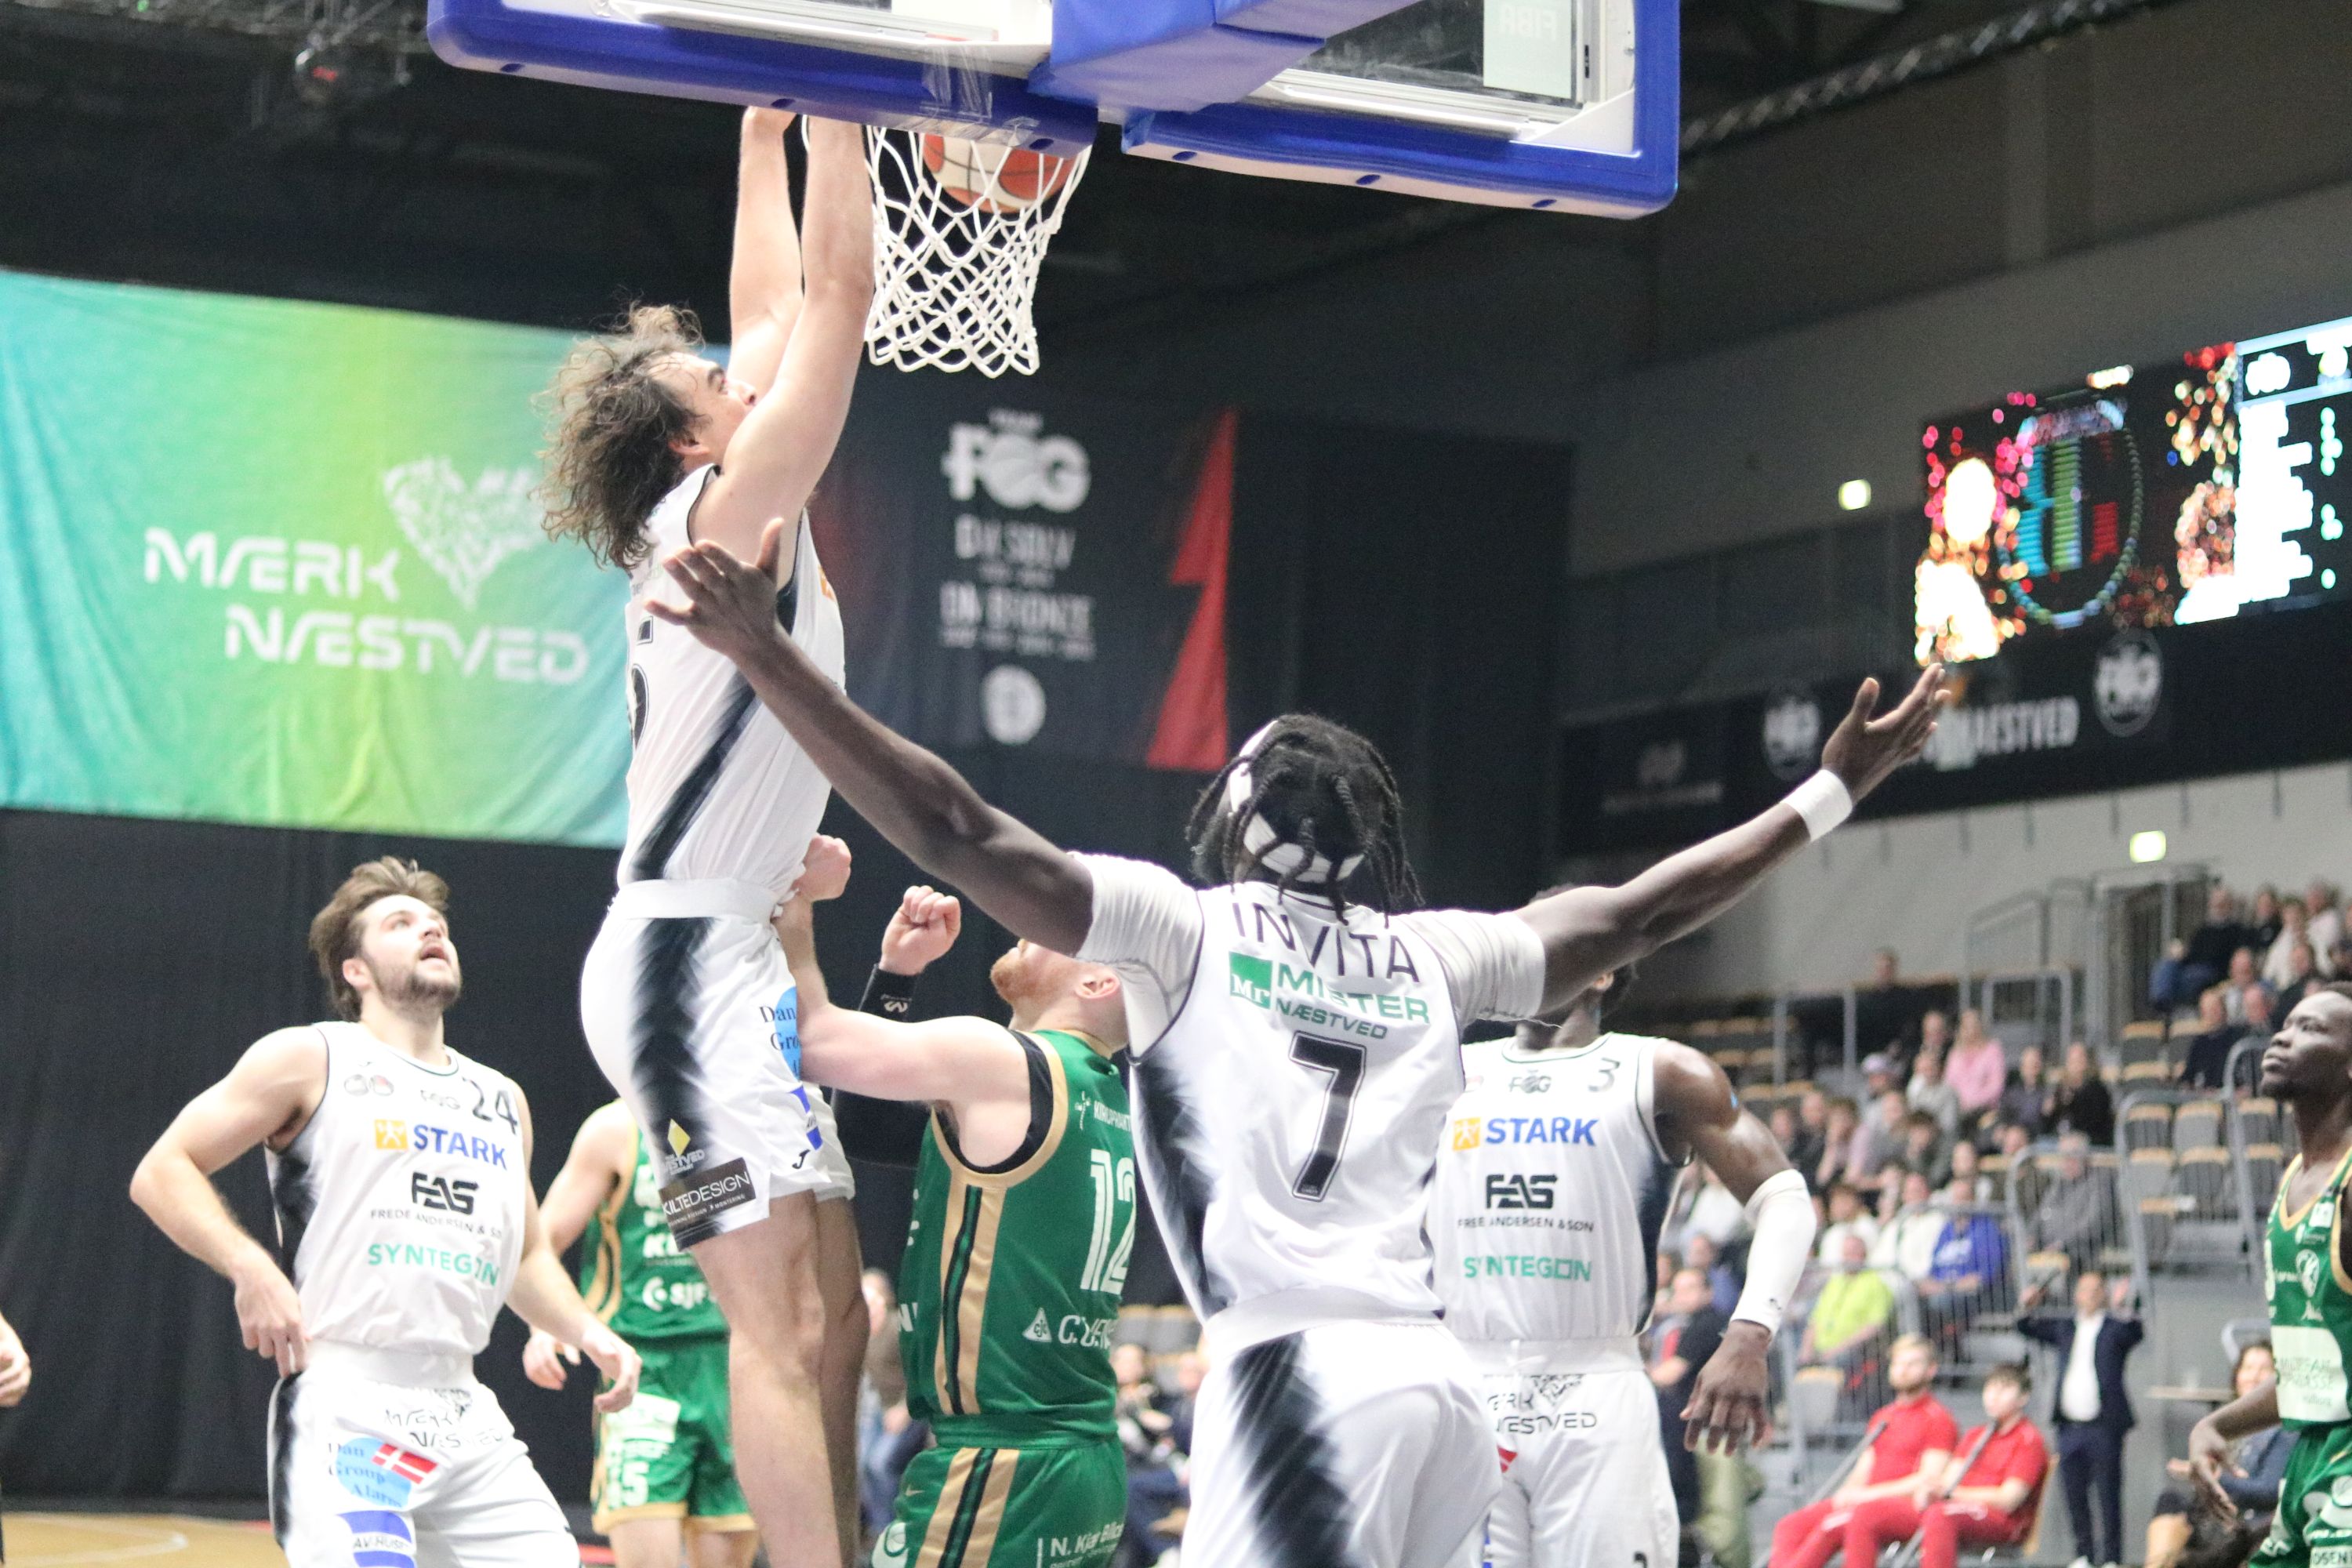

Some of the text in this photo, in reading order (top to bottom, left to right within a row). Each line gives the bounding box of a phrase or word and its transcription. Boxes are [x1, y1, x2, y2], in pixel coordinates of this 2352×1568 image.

[144, 526, 400, 602] MÆRK
[225, 604, 590, 686] NÆSTVED
[1232, 902, 1421, 982] INVITA
[1232, 973, 1271, 1004] Mr
[1278, 962, 1432, 1024] MISTER
[759, 1005, 797, 1023] Dan
[1276, 998, 1388, 1040] NÆSTVED
[1588, 1057, 1621, 1092] 3
[462, 1076, 518, 1135] 24
[1289, 1030, 1367, 1203] 7
[413, 1124, 507, 1171] STARK
[1485, 1116, 1599, 1147] STARK
[412, 1171, 479, 1215] FAS
[662, 1171, 751, 1216] KILTEDESIGN
[1486, 1174, 1559, 1209] FAS
[371, 1209, 411, 1220] FREDE
[1080, 1148, 1137, 1296] 12
[1464, 1255, 1592, 1283] SNTEGON
[1487, 1392, 1535, 1411] ÆRK
[408, 1428, 503, 1449] NÆSED
[350, 1483, 402, 1508] Alarm
